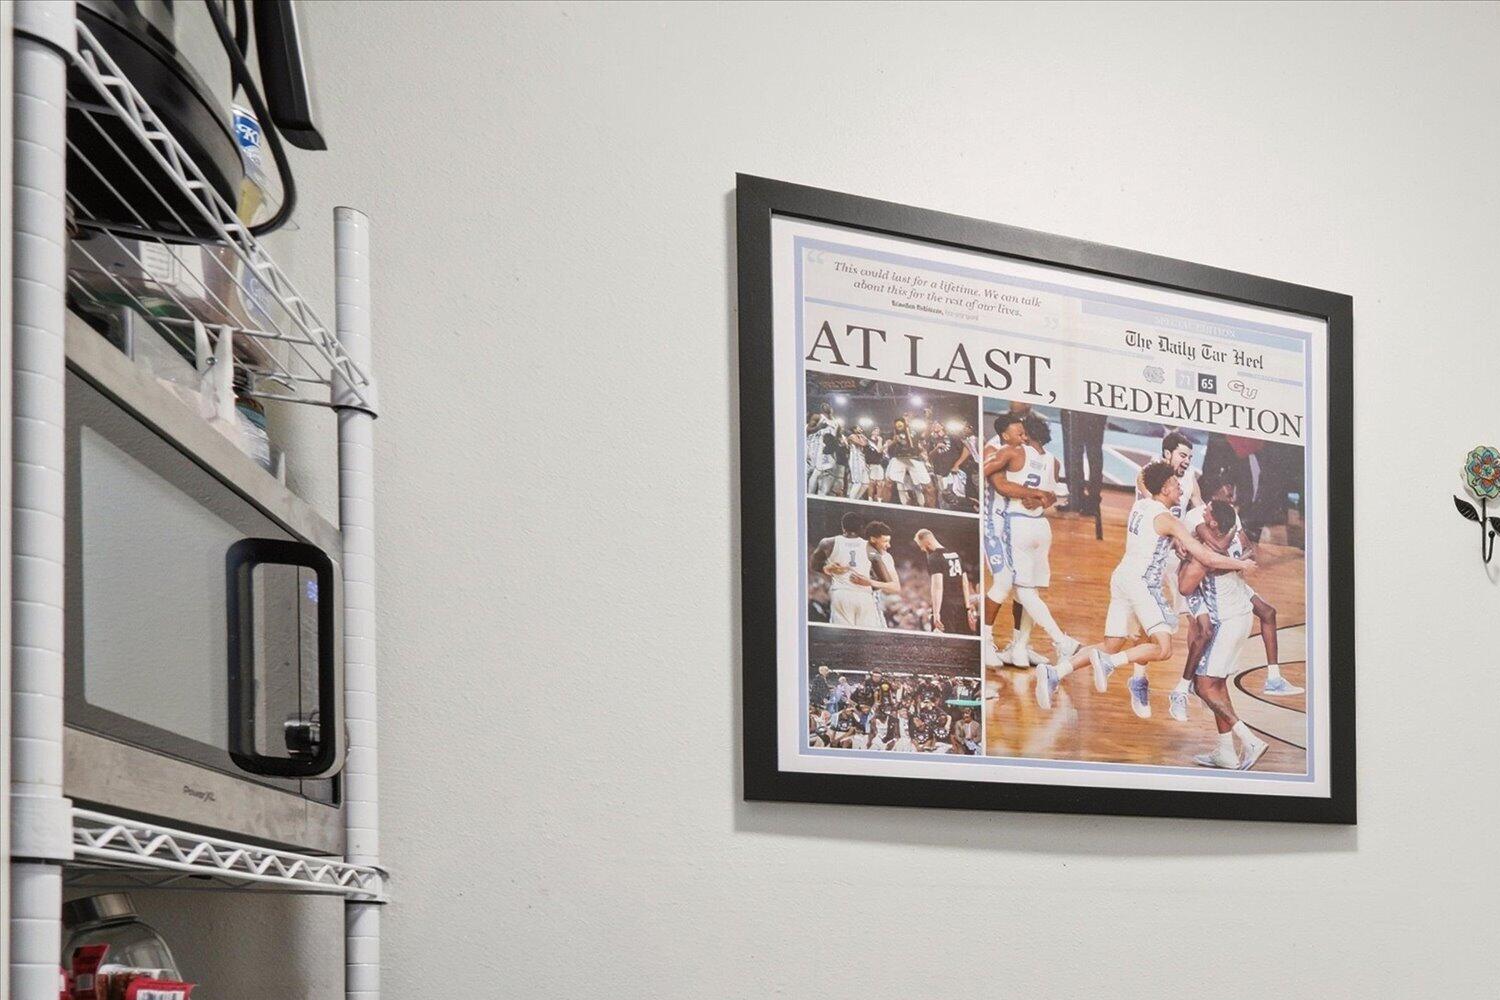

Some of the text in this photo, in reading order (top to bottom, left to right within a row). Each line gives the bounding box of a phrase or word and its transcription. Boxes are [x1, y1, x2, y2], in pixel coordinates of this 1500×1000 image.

[834, 262, 858, 274] This
[860, 269, 890, 280] could
[892, 272, 911, 284] last
[912, 276, 928, 287] for
[939, 280, 981, 297] lifetime.
[984, 288, 999, 300] We
[1001, 294, 1018, 304] can
[1021, 297, 1042, 308] talk
[853, 279, 1022, 317] about this for the rest of our lives.
[805, 320, 1057, 404] AT LAST,
[1125, 330, 1153, 351] The
[1158, 336, 1196, 361] Daily
[1201, 343, 1228, 363] Tar
[1232, 349, 1264, 370] Heel
[1201, 377, 1214, 391] 65
[1083, 379, 1303, 438] REDEMPTION
